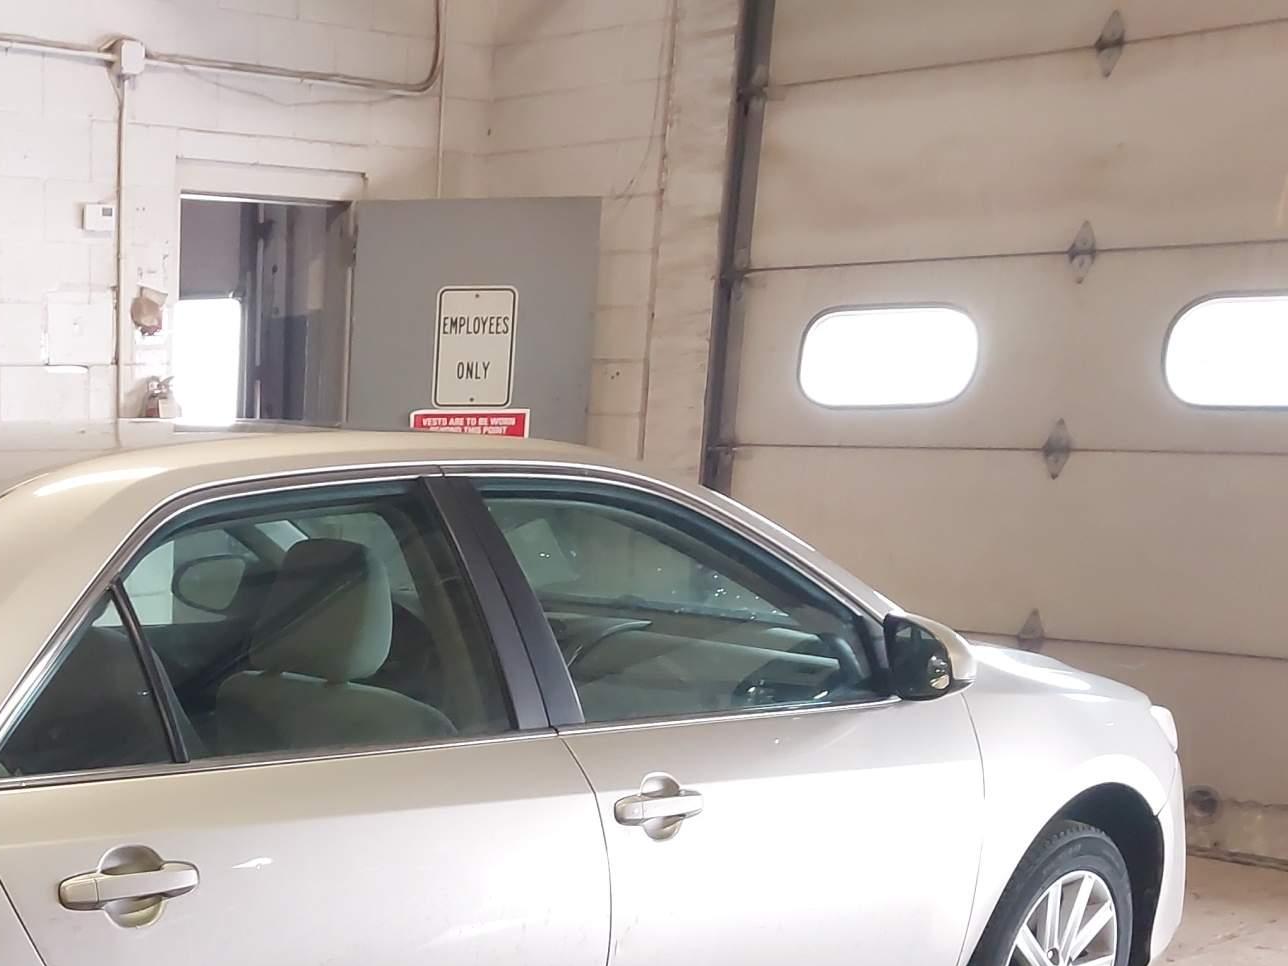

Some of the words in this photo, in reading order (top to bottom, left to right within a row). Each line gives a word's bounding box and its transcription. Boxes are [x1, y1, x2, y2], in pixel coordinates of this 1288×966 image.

[442, 316, 510, 335] EMPLOYEES
[456, 361, 491, 380] ONLY
[465, 417, 477, 426] TO
